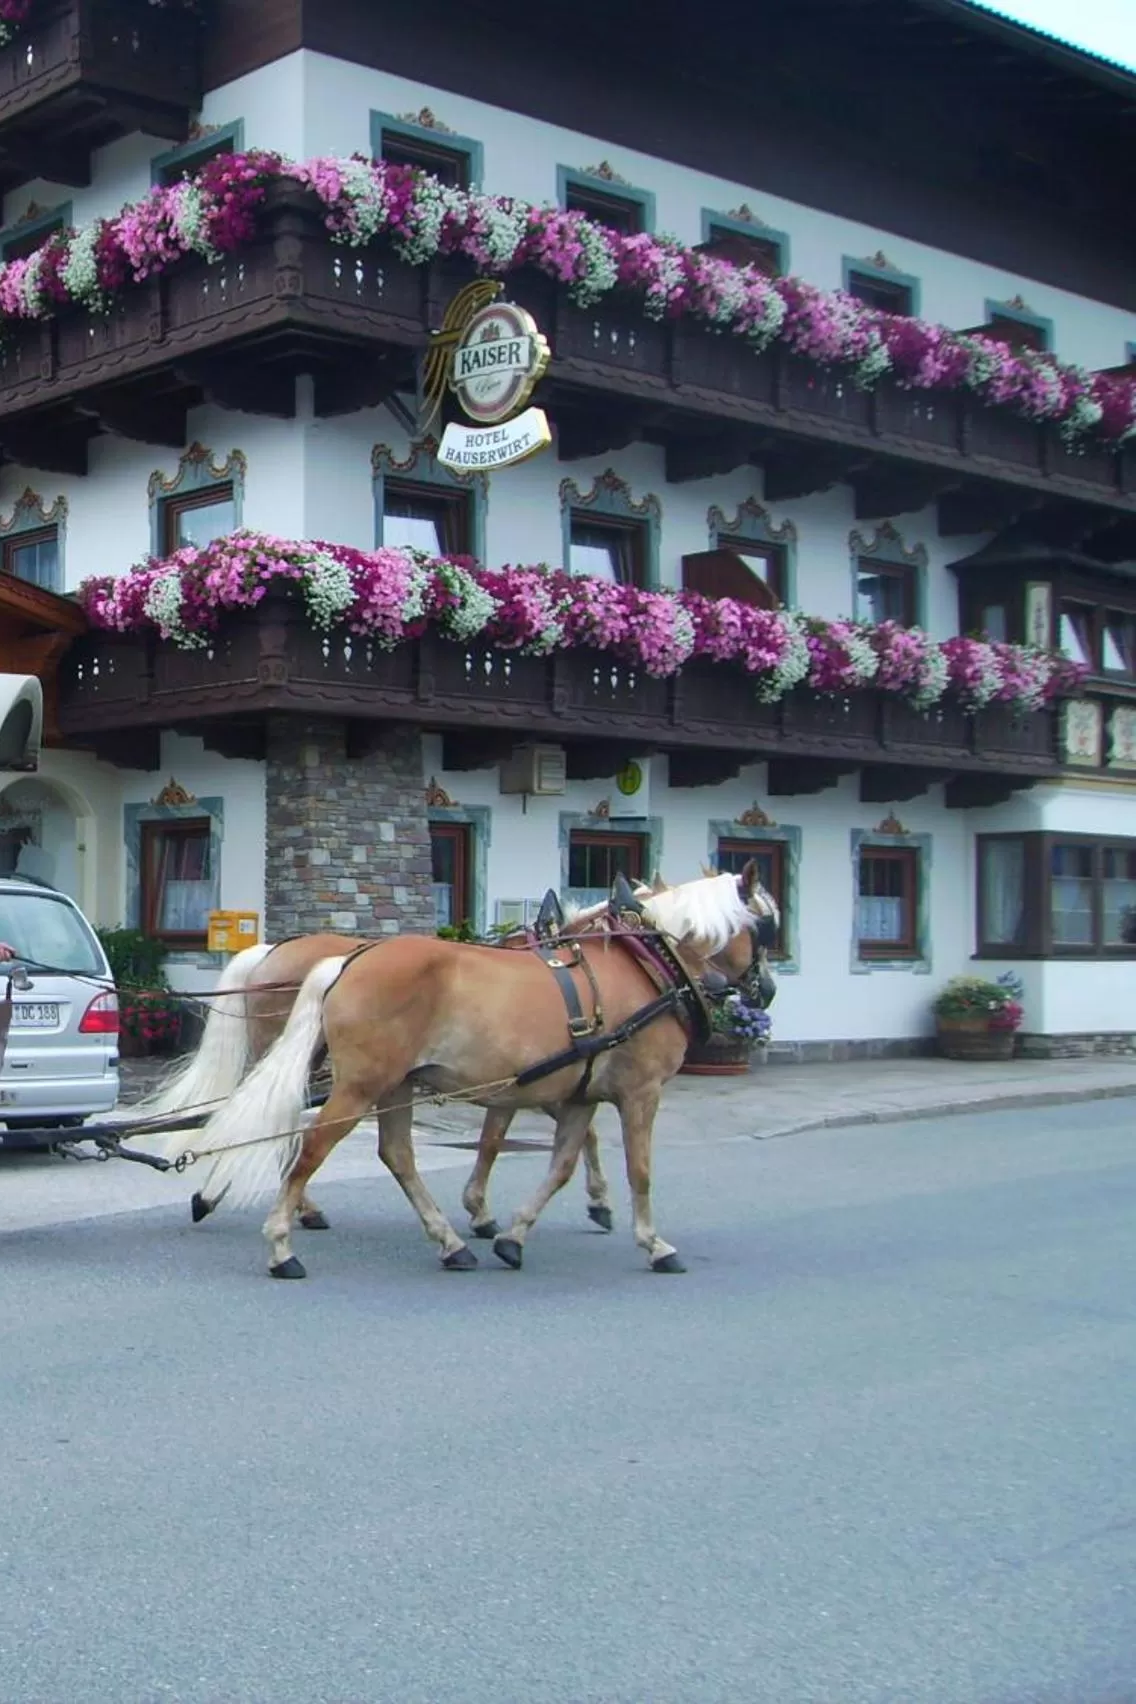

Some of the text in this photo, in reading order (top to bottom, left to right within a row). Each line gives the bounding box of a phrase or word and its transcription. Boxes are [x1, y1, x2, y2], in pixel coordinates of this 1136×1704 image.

[461, 342, 521, 376] KAISER
[445, 432, 531, 464] HAUSERWIRT
[465, 428, 509, 448] HOTEL
